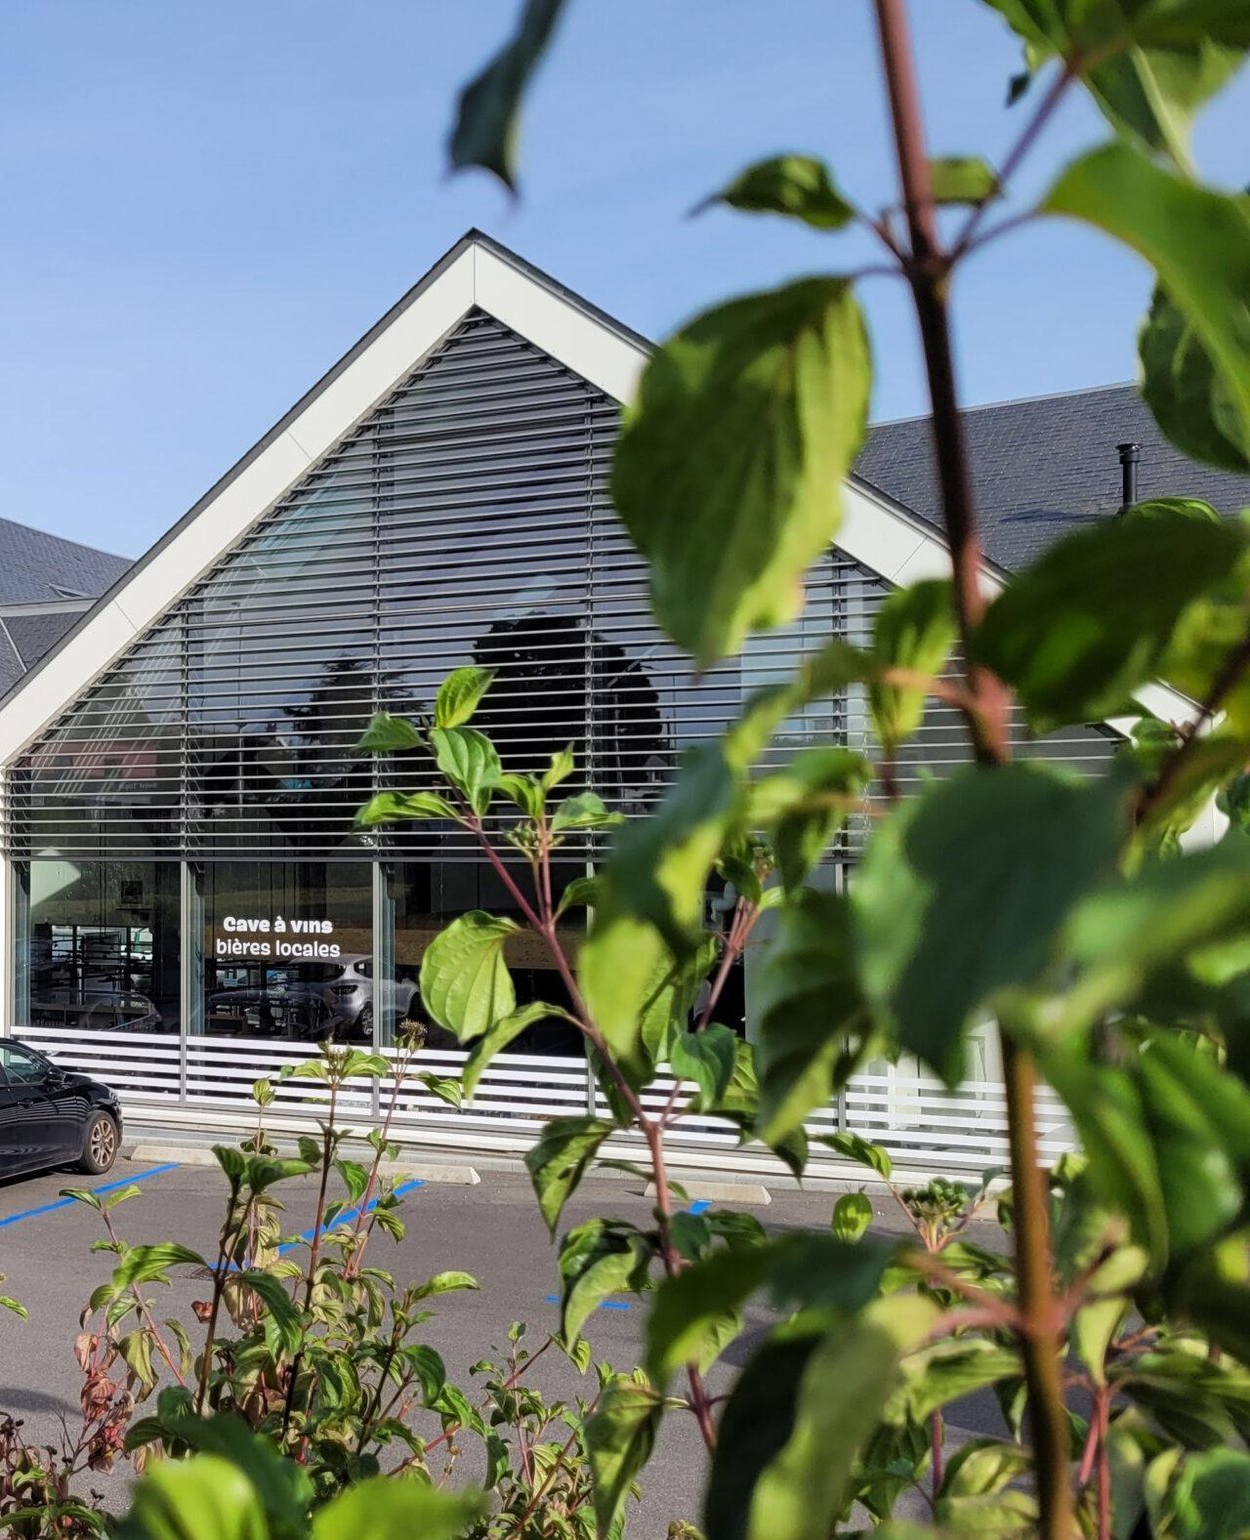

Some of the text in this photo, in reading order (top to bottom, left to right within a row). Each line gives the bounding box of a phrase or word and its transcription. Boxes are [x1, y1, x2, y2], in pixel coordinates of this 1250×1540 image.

[223, 915, 334, 934] Cave à vins
[216, 938, 341, 958] bières locales
